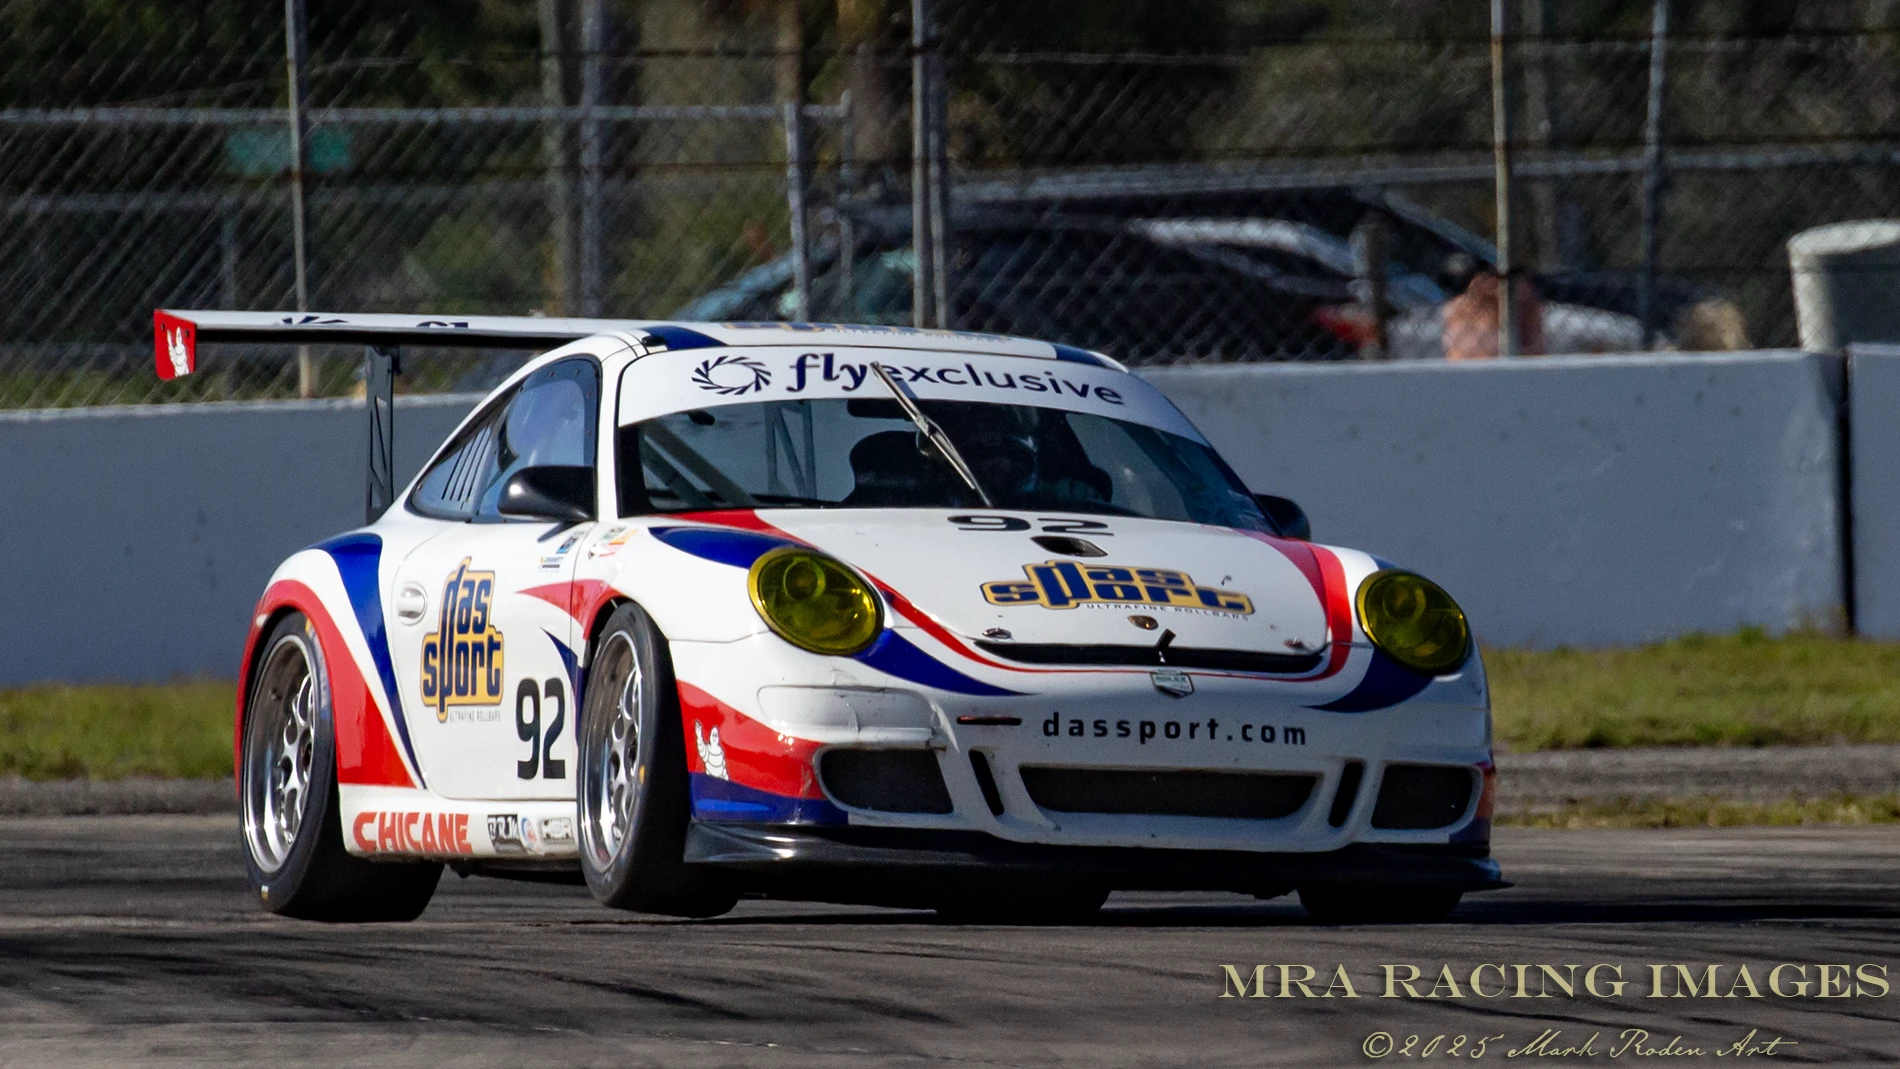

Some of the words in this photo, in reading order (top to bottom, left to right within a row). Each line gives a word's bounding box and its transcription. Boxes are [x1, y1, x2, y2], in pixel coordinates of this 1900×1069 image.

[948, 515, 1114, 536] 92
[1086, 603, 1167, 613] ULTRAFINE
[1173, 608, 1250, 622] ROLLBARS
[516, 677, 566, 780] 92
[1042, 711, 1306, 745] dassport.com
[353, 812, 473, 854] CHICANE
